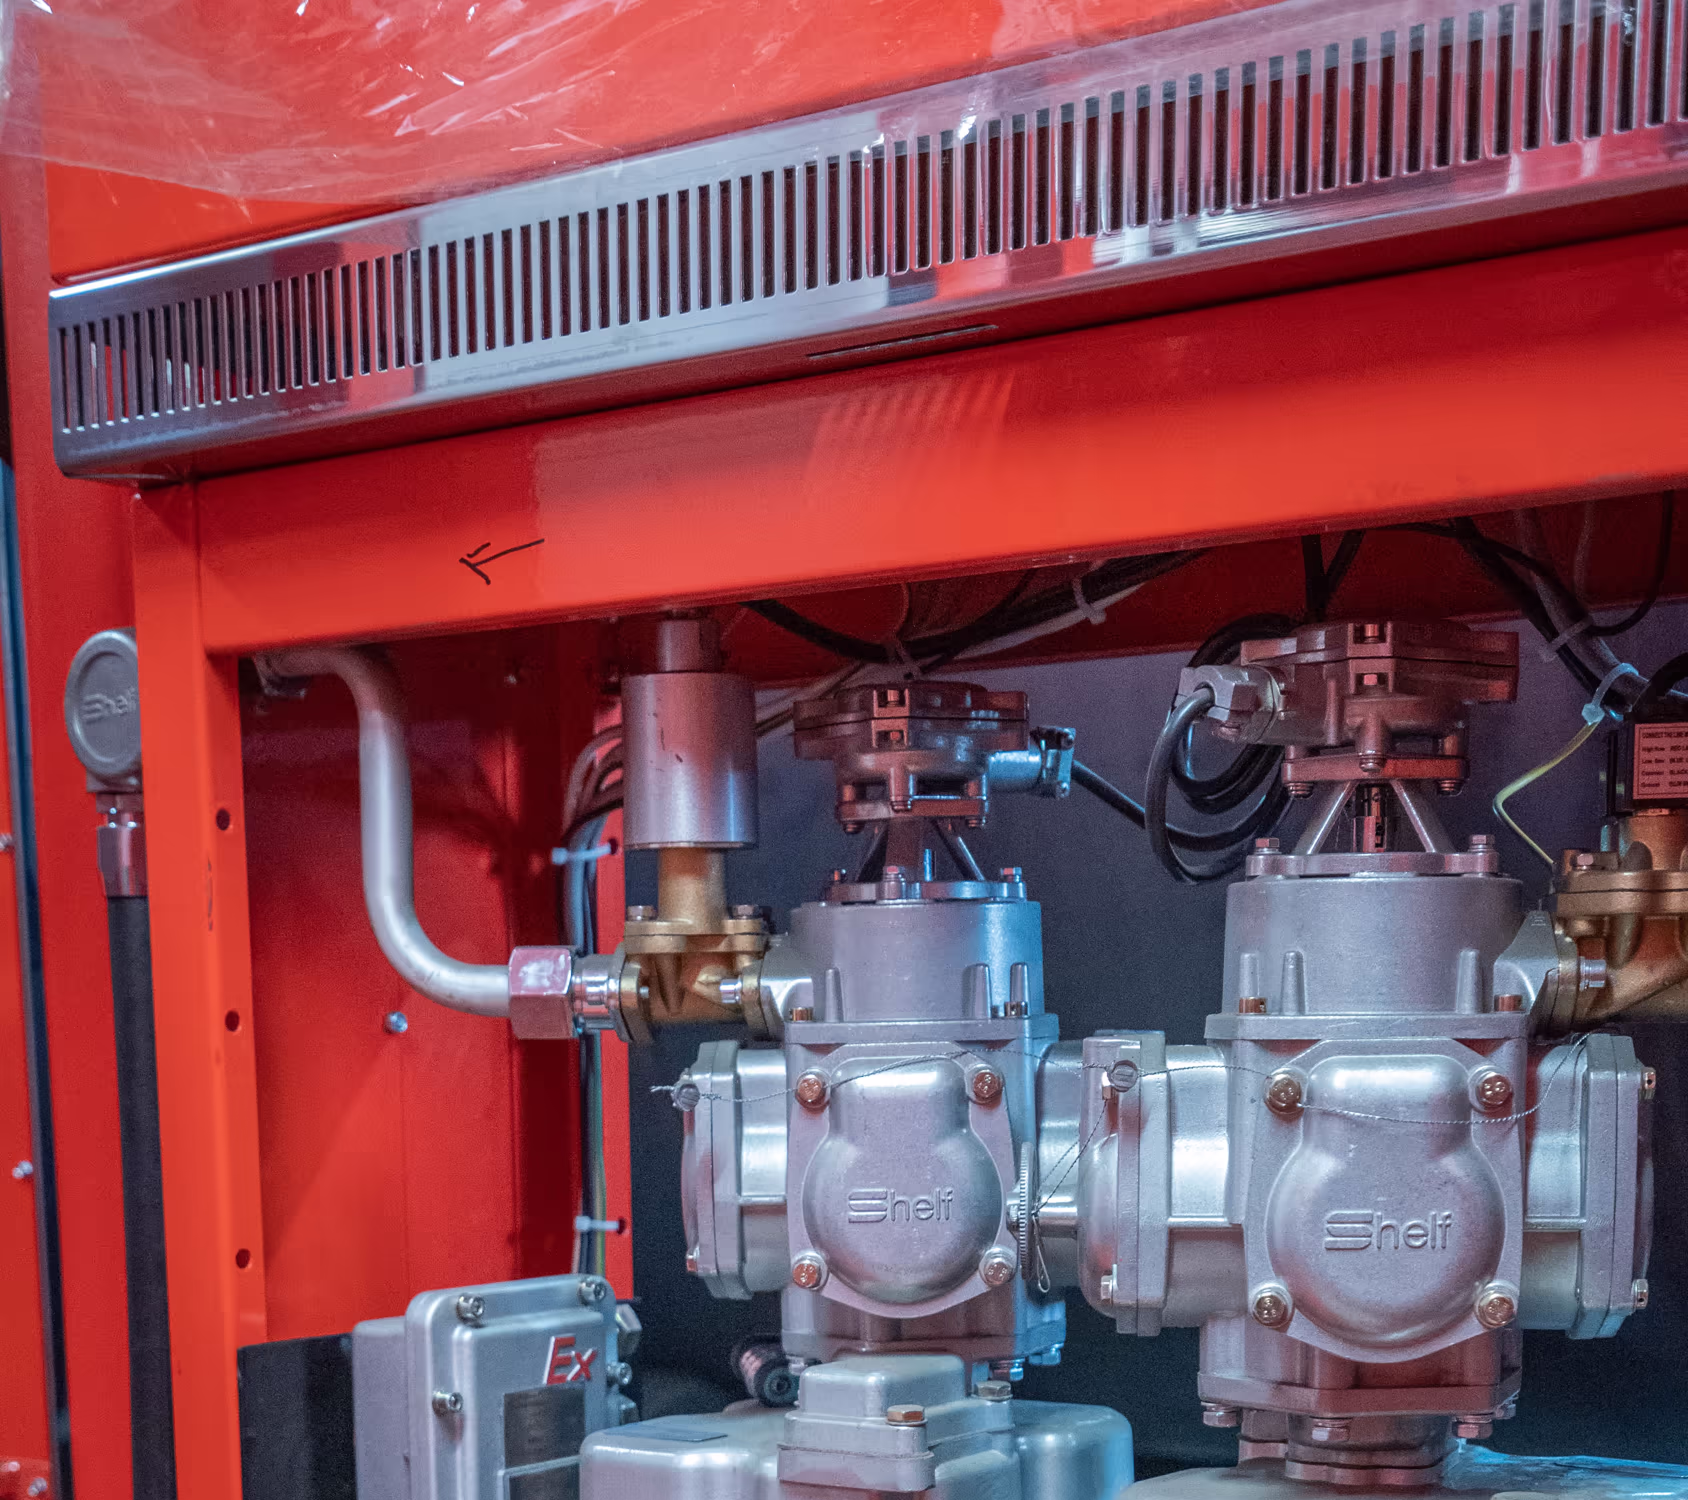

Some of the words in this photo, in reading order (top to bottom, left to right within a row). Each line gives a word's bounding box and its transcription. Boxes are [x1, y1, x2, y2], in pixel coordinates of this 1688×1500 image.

[847, 1187, 954, 1224] Shelf
[1323, 1210, 1453, 1251] Shelf
[542, 1333, 598, 1386] Ex
